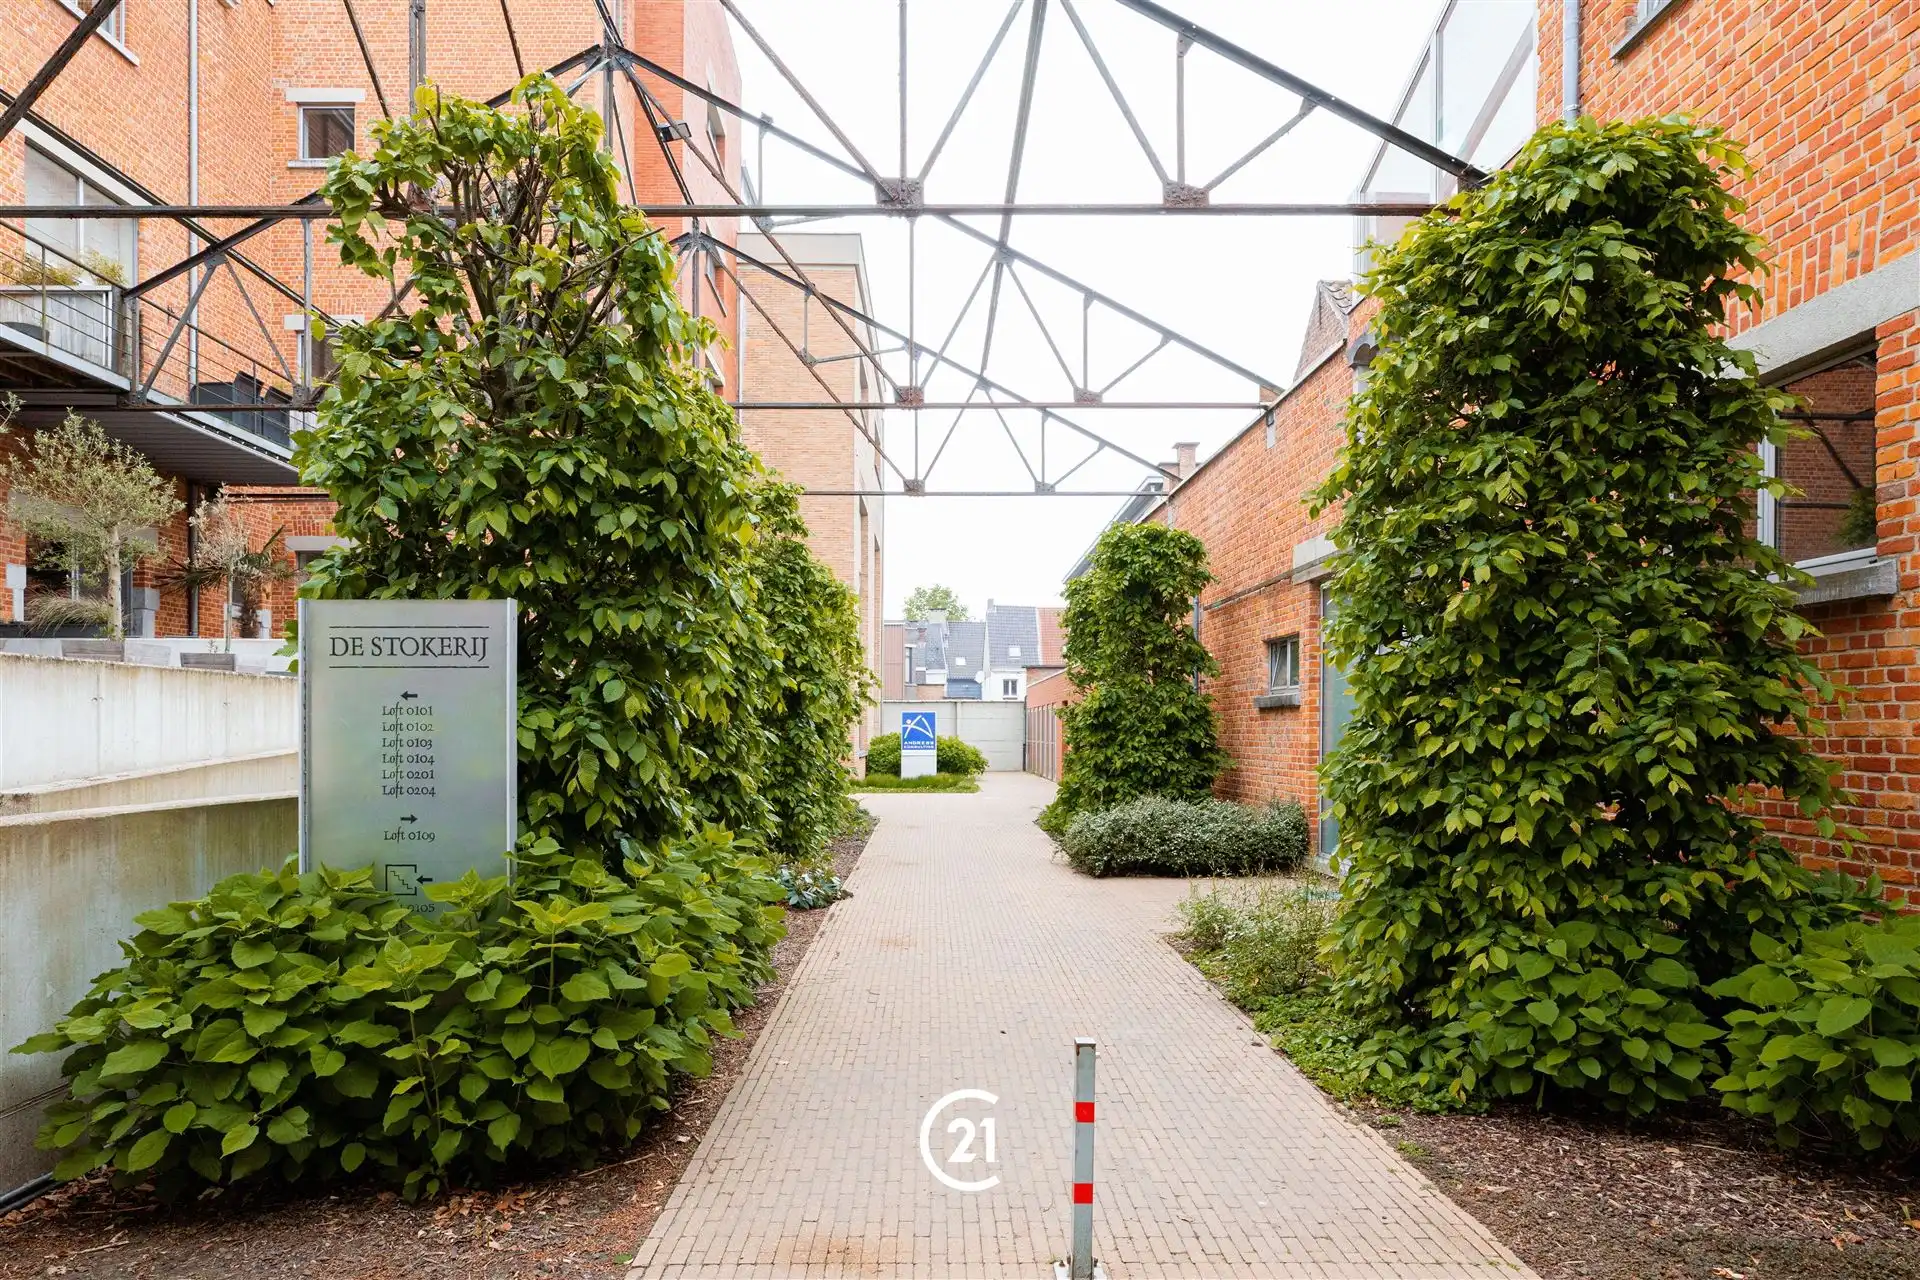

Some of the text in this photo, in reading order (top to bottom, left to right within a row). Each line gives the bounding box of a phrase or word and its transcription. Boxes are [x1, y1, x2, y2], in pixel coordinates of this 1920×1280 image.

[329, 636, 489, 662] DE STOKERIJ
[382, 702, 433, 719] Loft 0101
[382, 718, 433, 735] Loft 0102
[382, 734, 433, 750] Loft 0103
[382, 750, 435, 767] Loft 0104
[382, 766, 434, 782] Loft 0201
[382, 781, 436, 798] Loft 0204
[384, 826, 436, 844] Loft 0109
